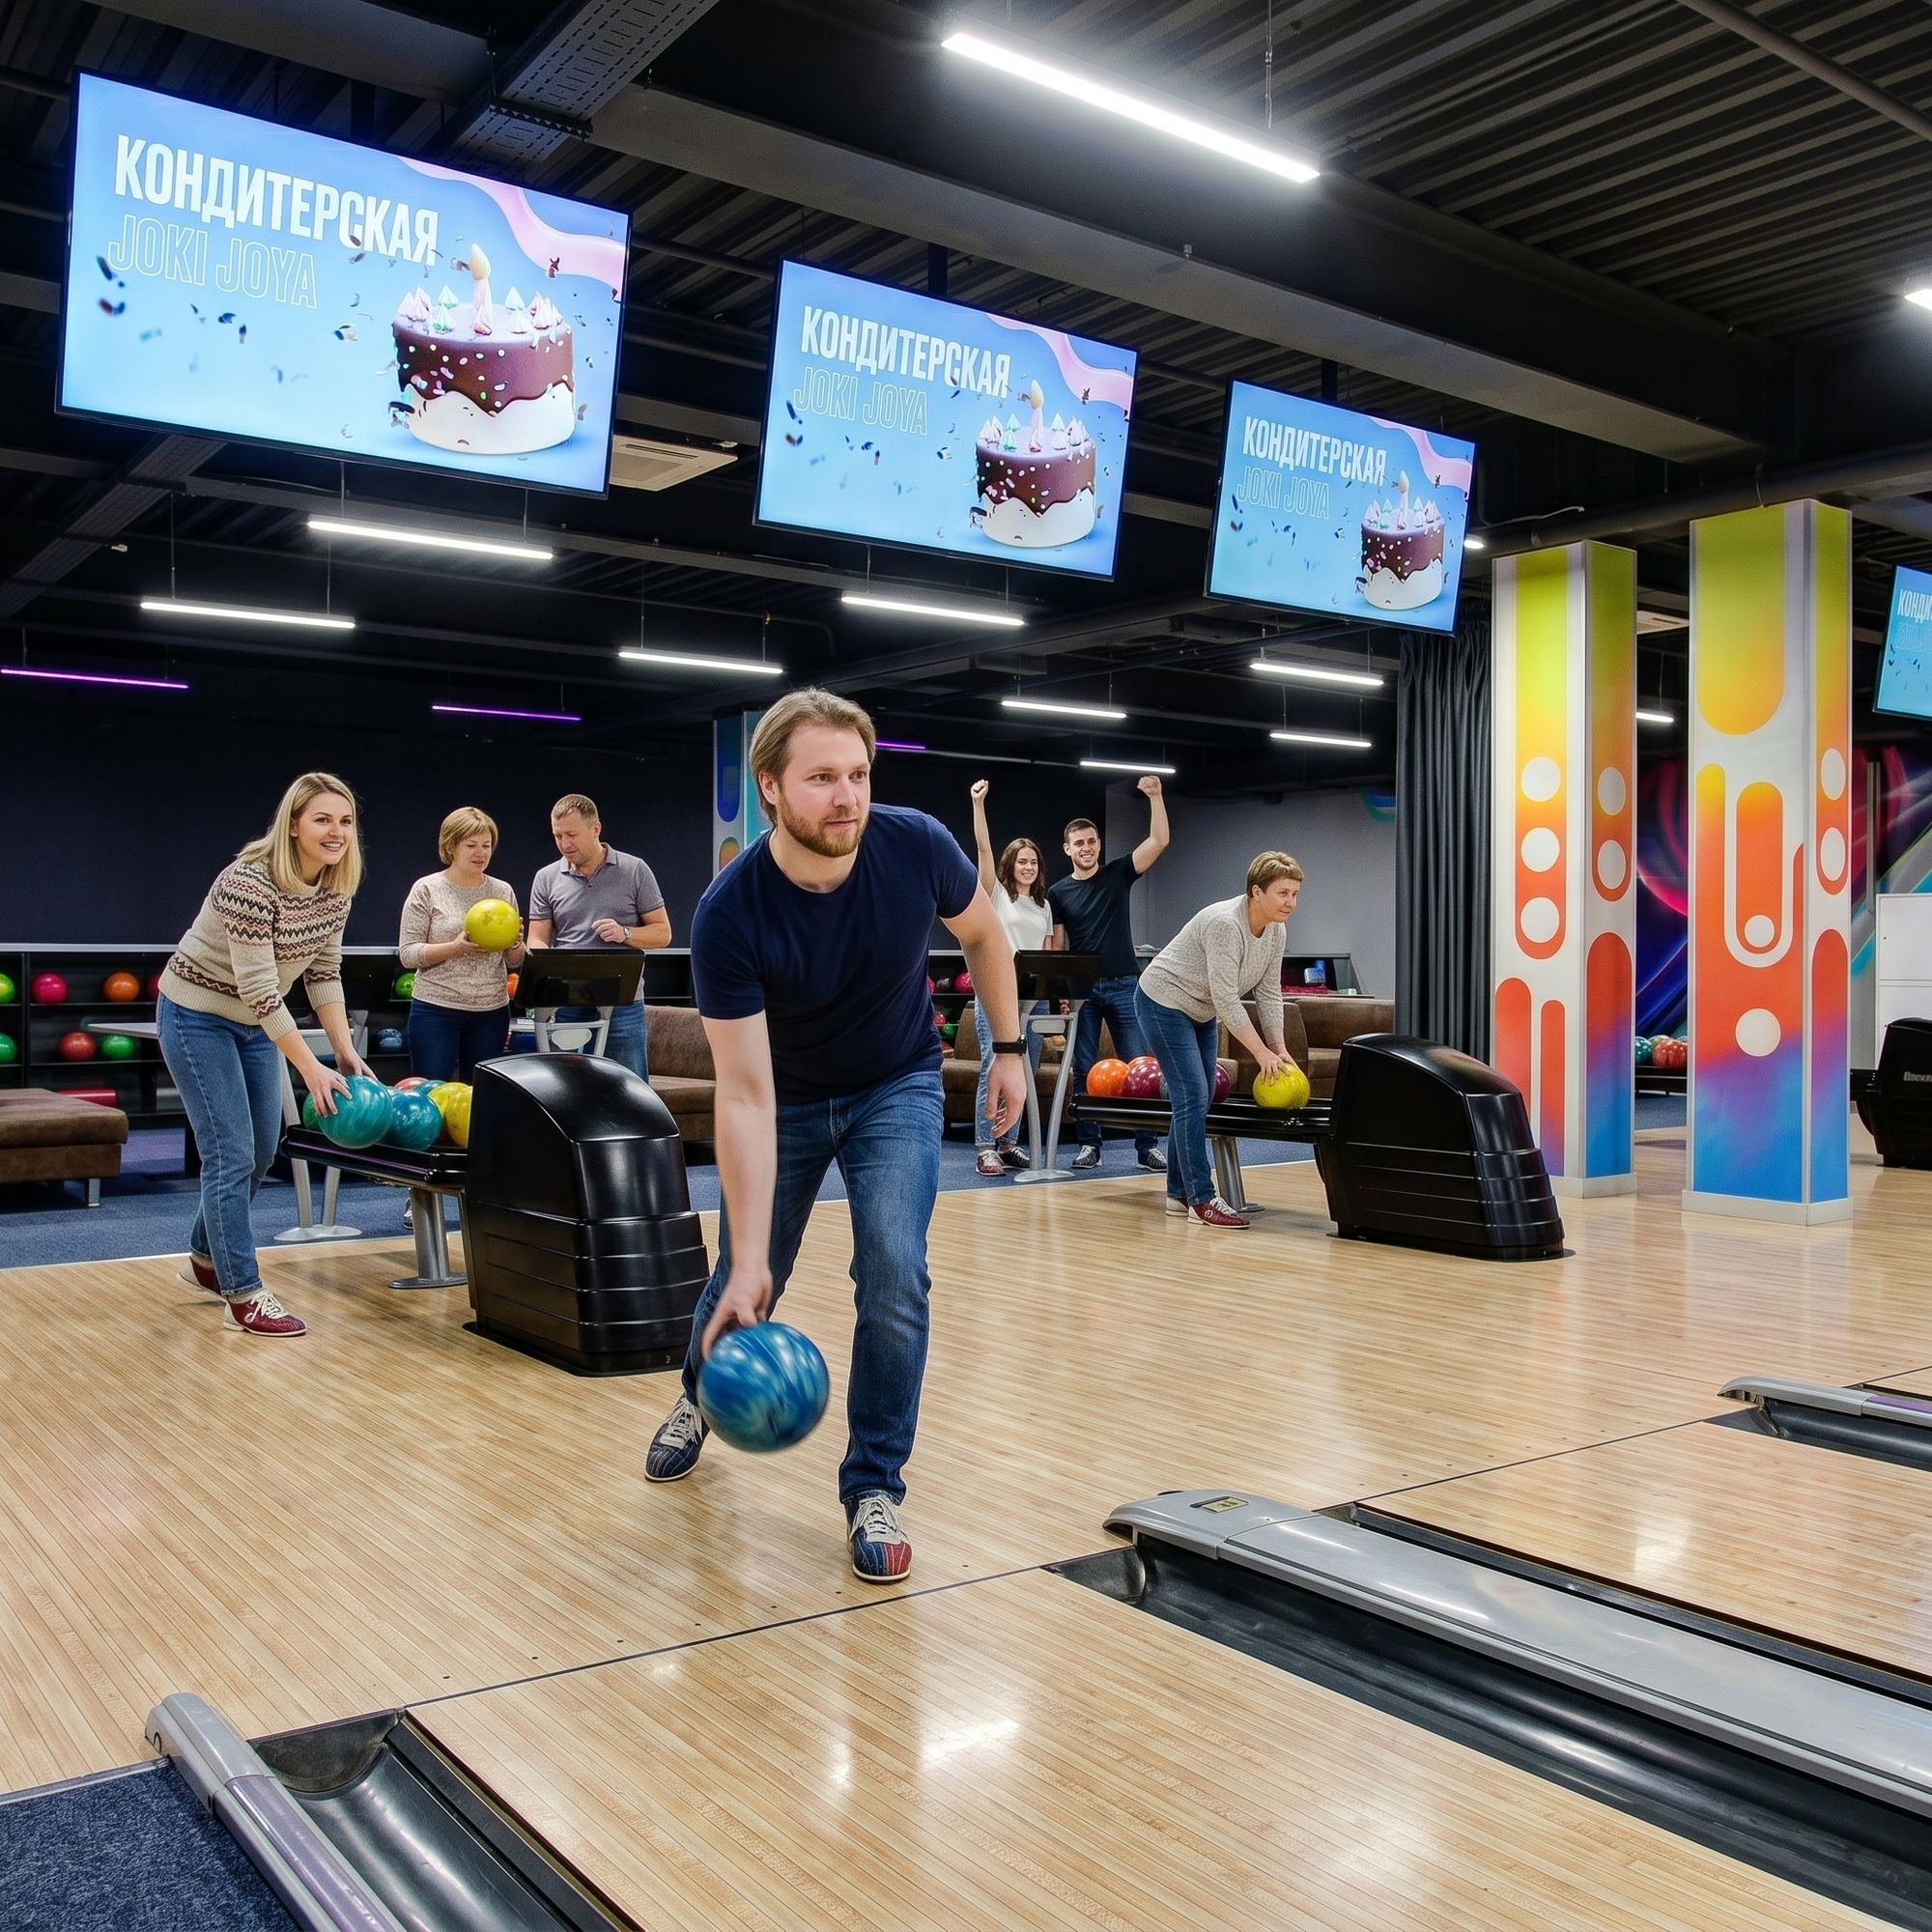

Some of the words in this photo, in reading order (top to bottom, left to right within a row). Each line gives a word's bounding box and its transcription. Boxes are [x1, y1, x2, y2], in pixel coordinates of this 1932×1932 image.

[114, 133, 440, 267] КОНДИТЕРСКАЯ
[107, 213, 209, 287] JOKI
[214, 236, 317, 310] JOYA
[800, 304, 1012, 399] КОНДИТЕРСКАЯ
[793, 365, 859, 422] JOKI
[863, 381, 928, 436] JOYA
[1236, 465, 1283, 510] JOKI
[1283, 473, 1330, 520] JOYA
[1242, 415, 1387, 487] КОНДИТЕРСКАЯ
